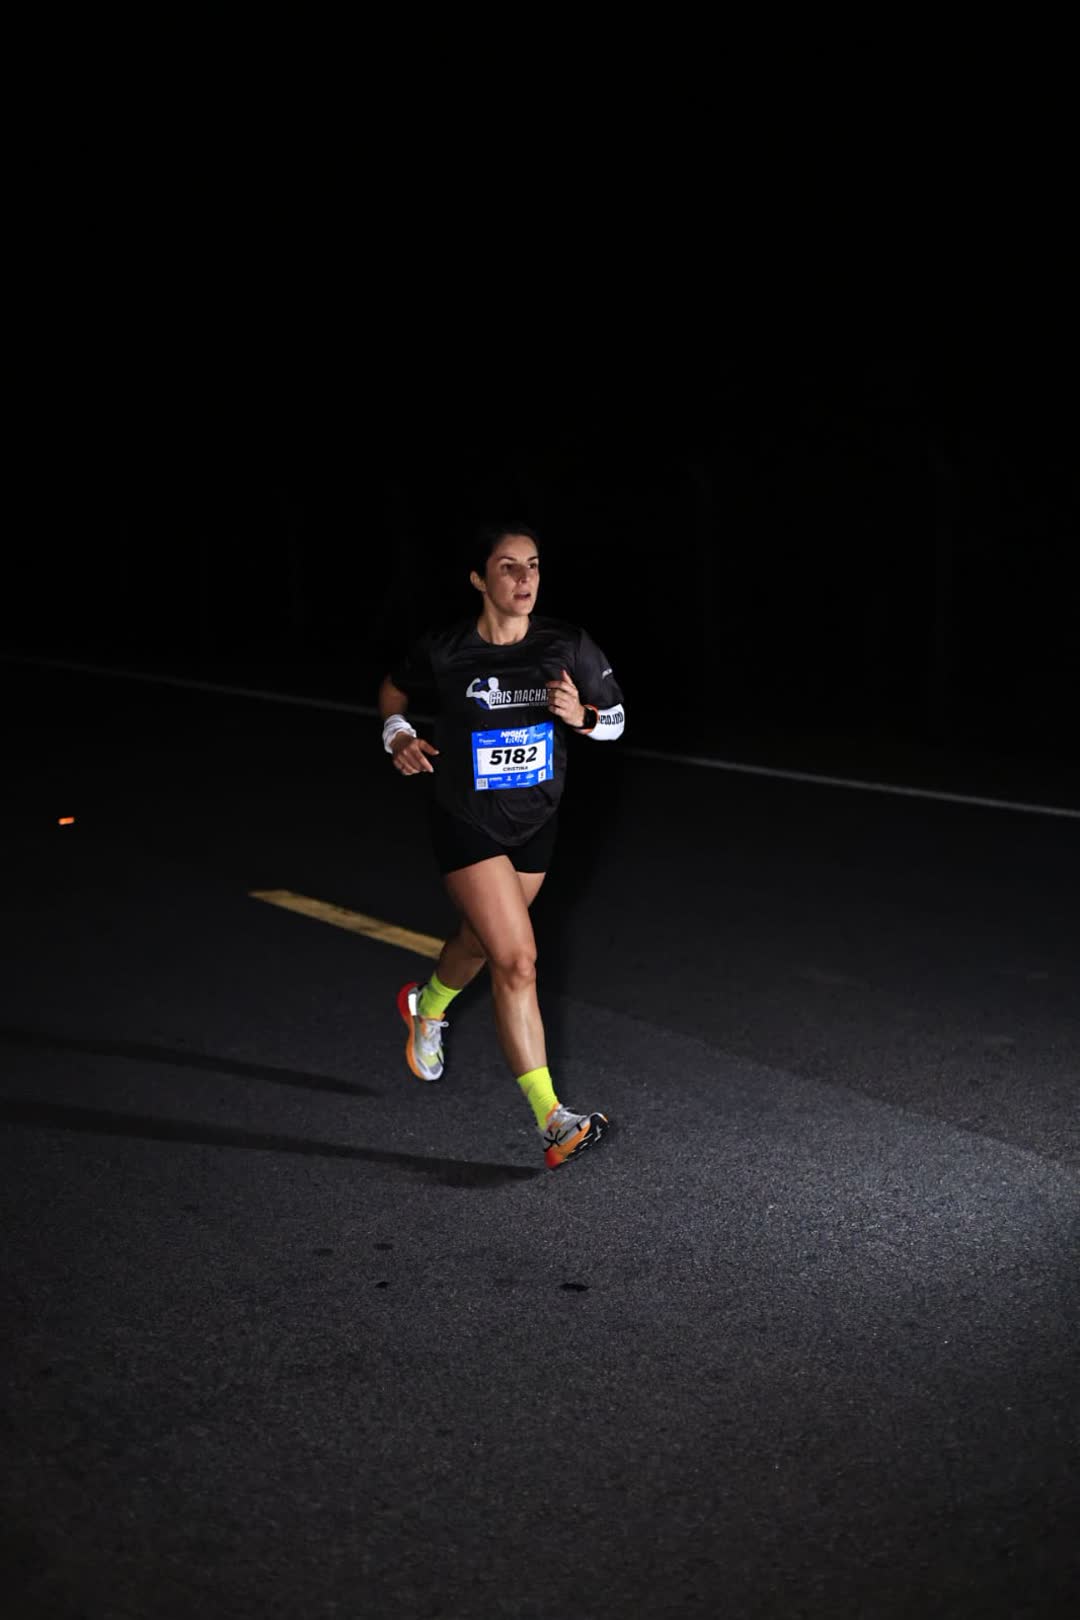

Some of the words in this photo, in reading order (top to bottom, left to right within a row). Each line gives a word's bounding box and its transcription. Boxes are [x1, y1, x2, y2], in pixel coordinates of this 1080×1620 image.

[489, 690, 512, 705] CRIS
[513, 688, 550, 703] MACHA
[489, 746, 538, 766] 5182
